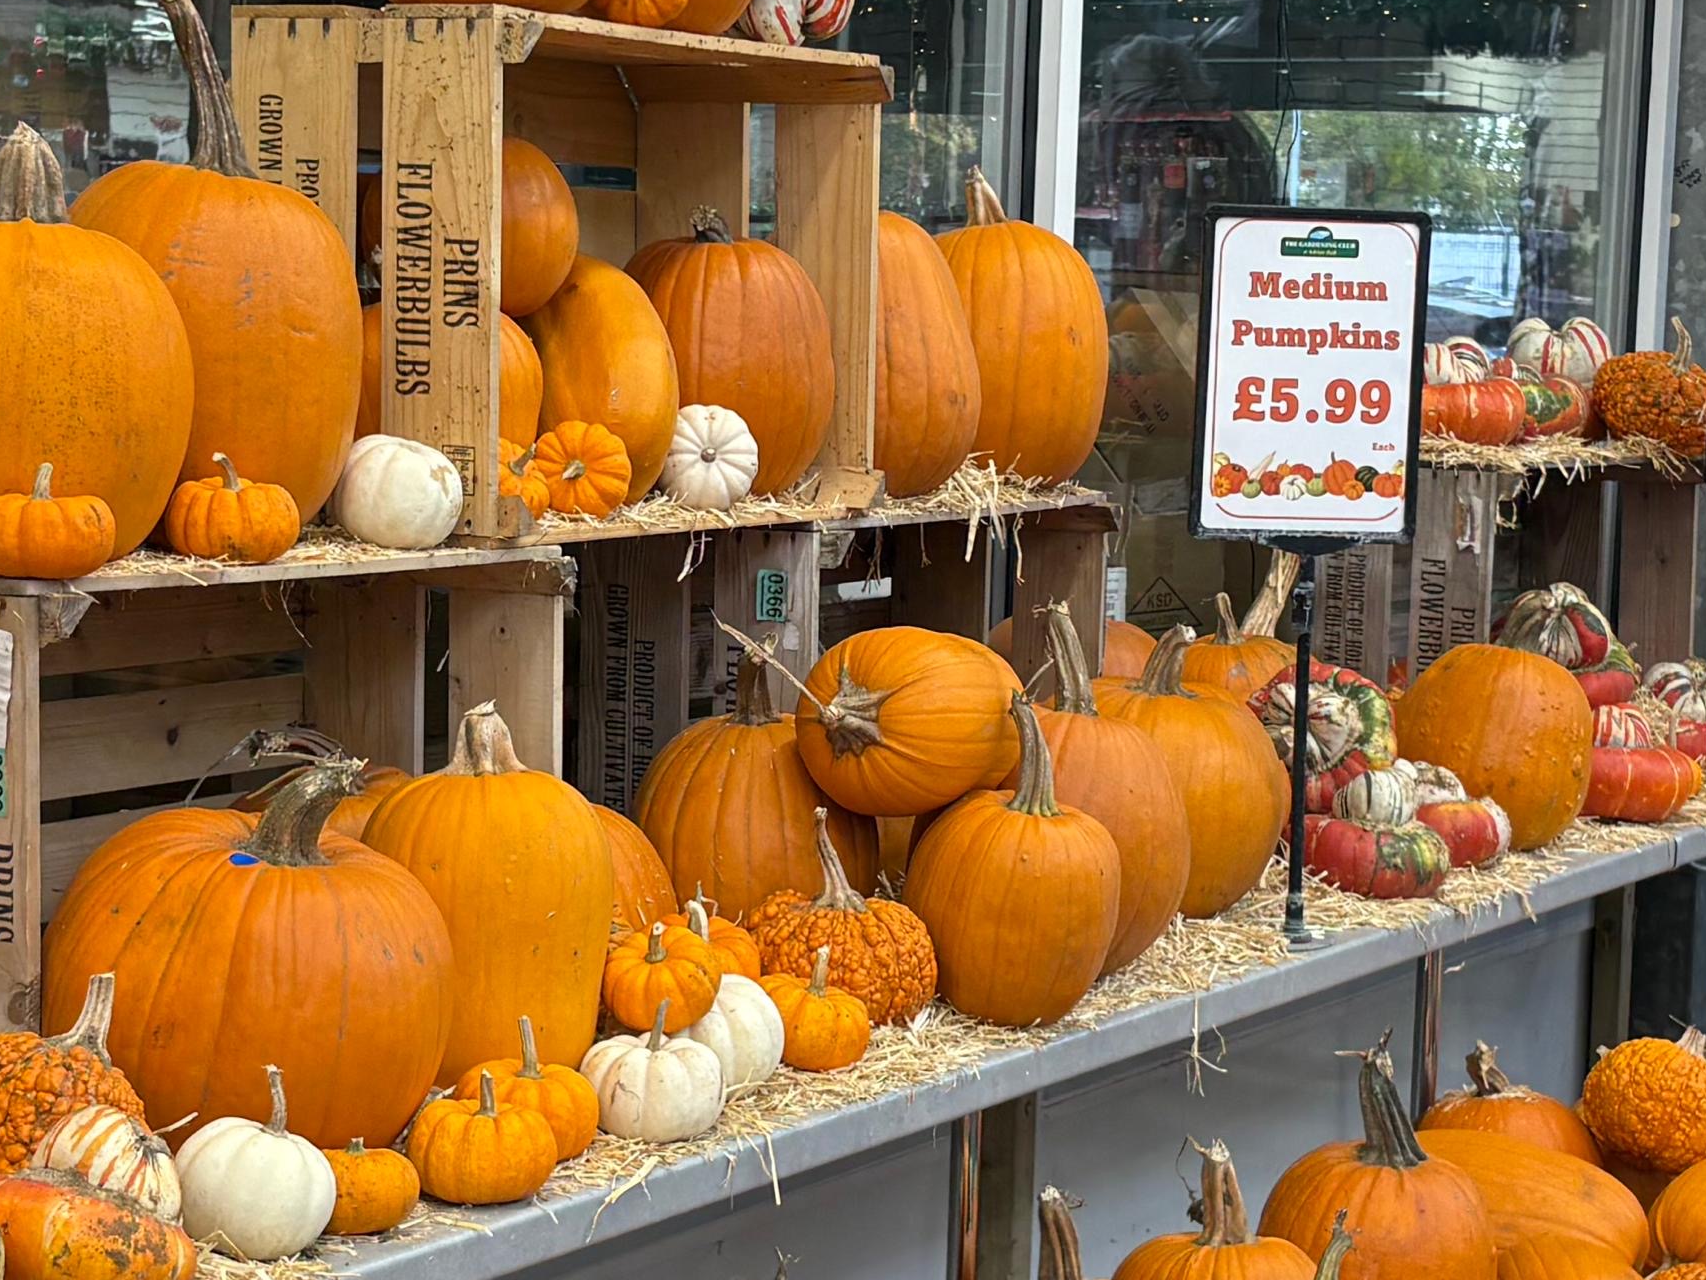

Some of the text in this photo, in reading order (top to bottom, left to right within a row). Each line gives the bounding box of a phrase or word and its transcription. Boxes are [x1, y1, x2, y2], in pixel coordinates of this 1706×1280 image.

[258, 94, 283, 171] GROWN
[395, 162, 433, 396] FLOWERBULBS
[443, 238, 480, 328] PRINS
[1249, 272, 1387, 300] Medium
[1232, 320, 1399, 354] Pumpkins
[1233, 378, 1391, 424] £5.99
[1372, 442, 1396, 452] Each
[766, 573, 784, 619] 0366
[1147, 593, 1172, 608] KSD
[1324, 605, 1342, 663] CULTIVA
[1450, 606, 1476, 646] PRI
[604, 583, 629, 813] GROWN FROM CULTIVATE
[633, 640, 655, 720] PRODUCT
[632, 727, 654, 748] OF
